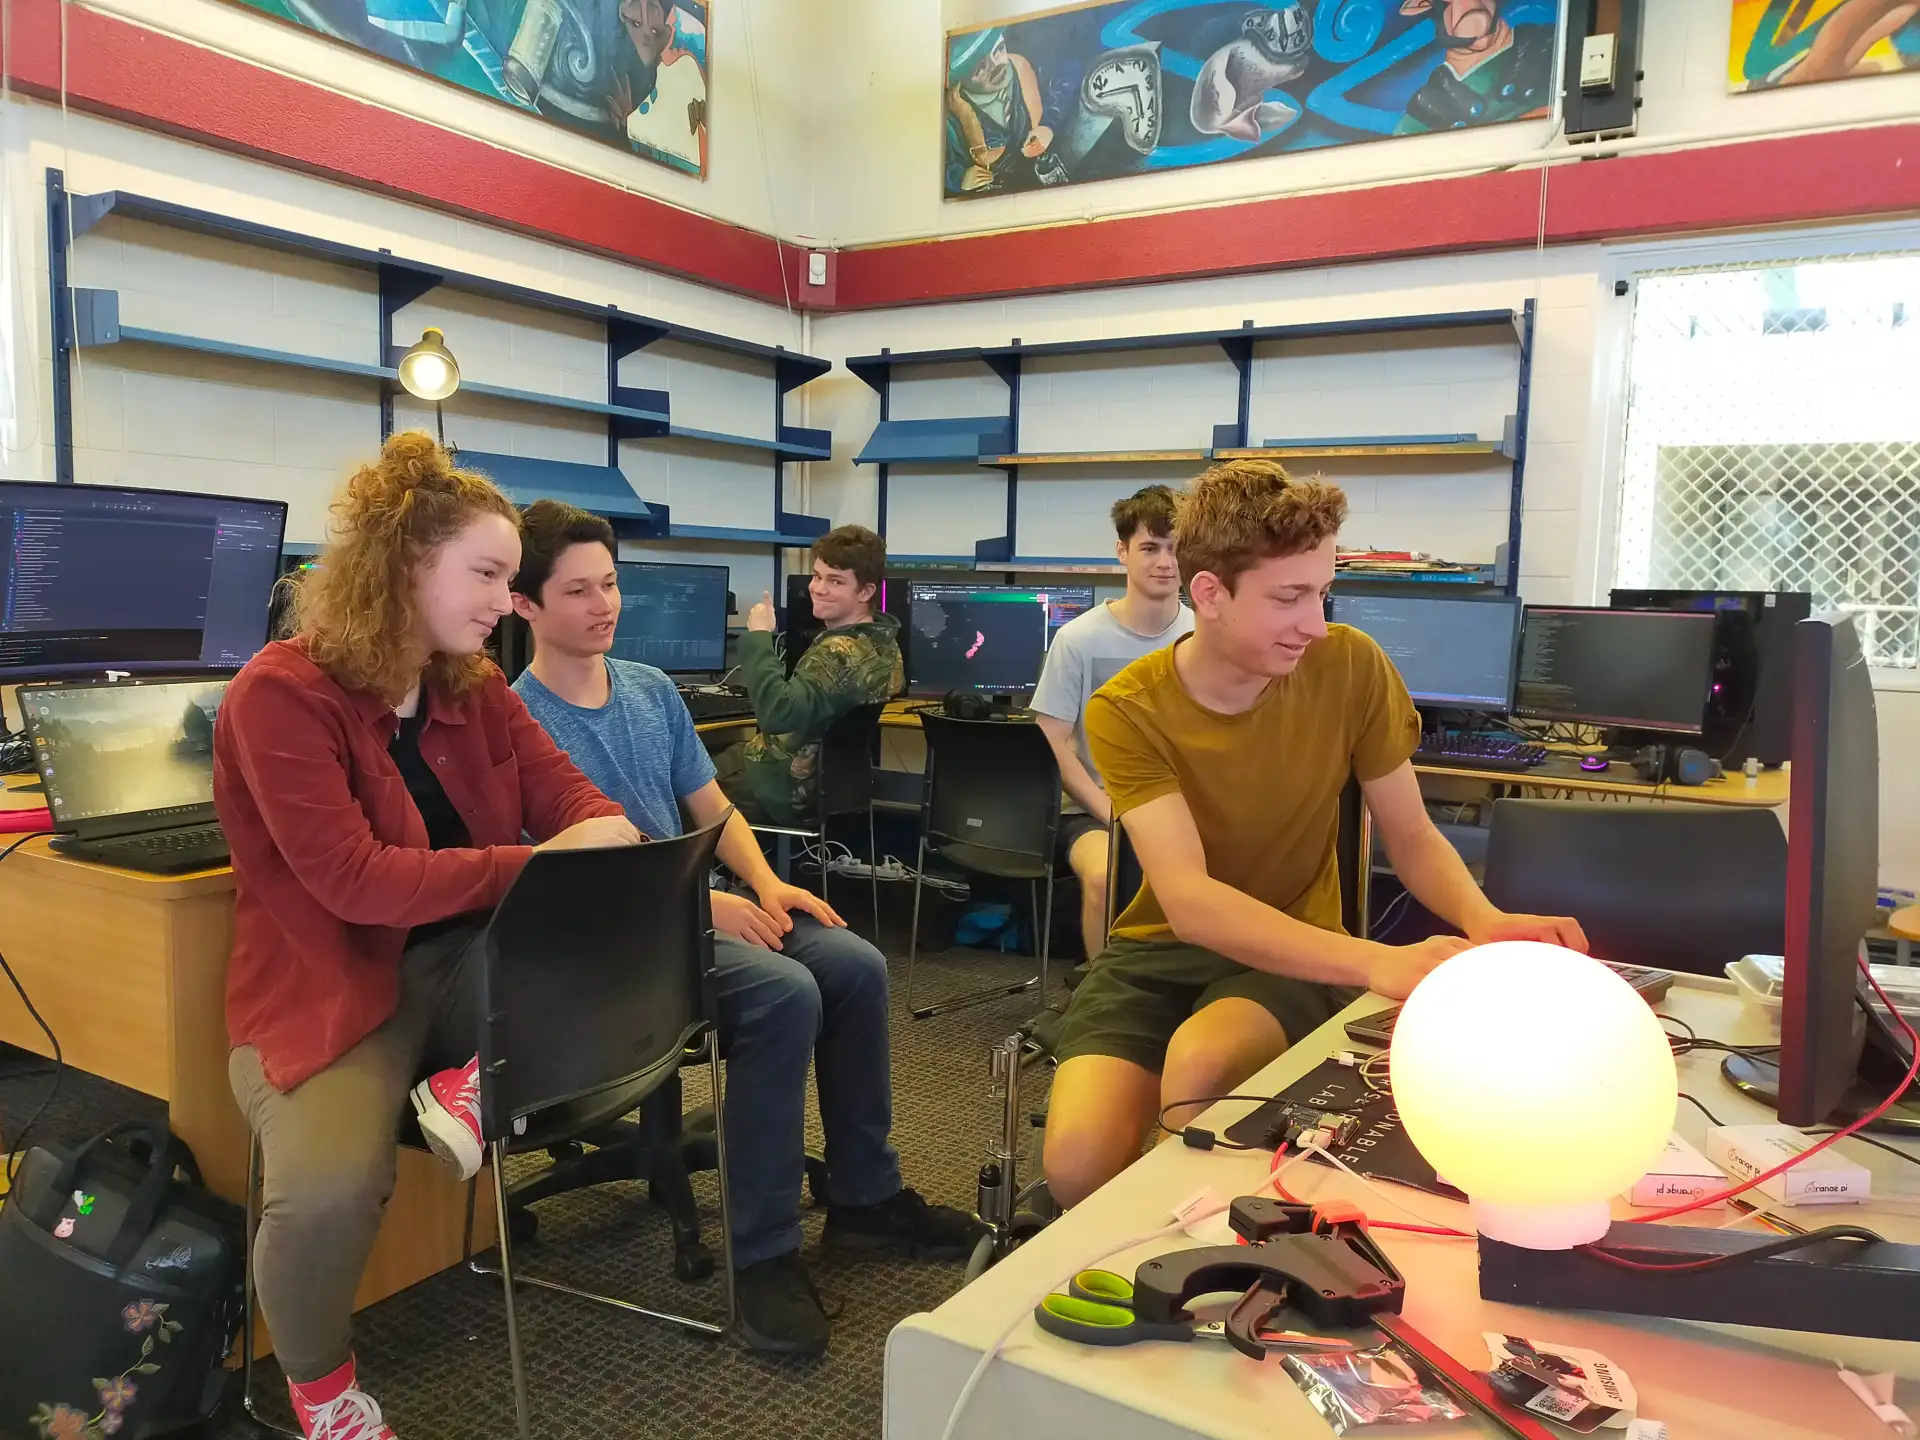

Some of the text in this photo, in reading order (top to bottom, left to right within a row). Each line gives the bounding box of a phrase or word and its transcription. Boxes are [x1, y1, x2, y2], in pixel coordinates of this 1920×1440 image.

[1308, 1083, 1346, 1106] LAB
[1337, 1108, 1402, 1164] ONABLE
[1656, 1183, 1665, 1196] pi
[1593, 1363, 1623, 1403] SAMSUNG
